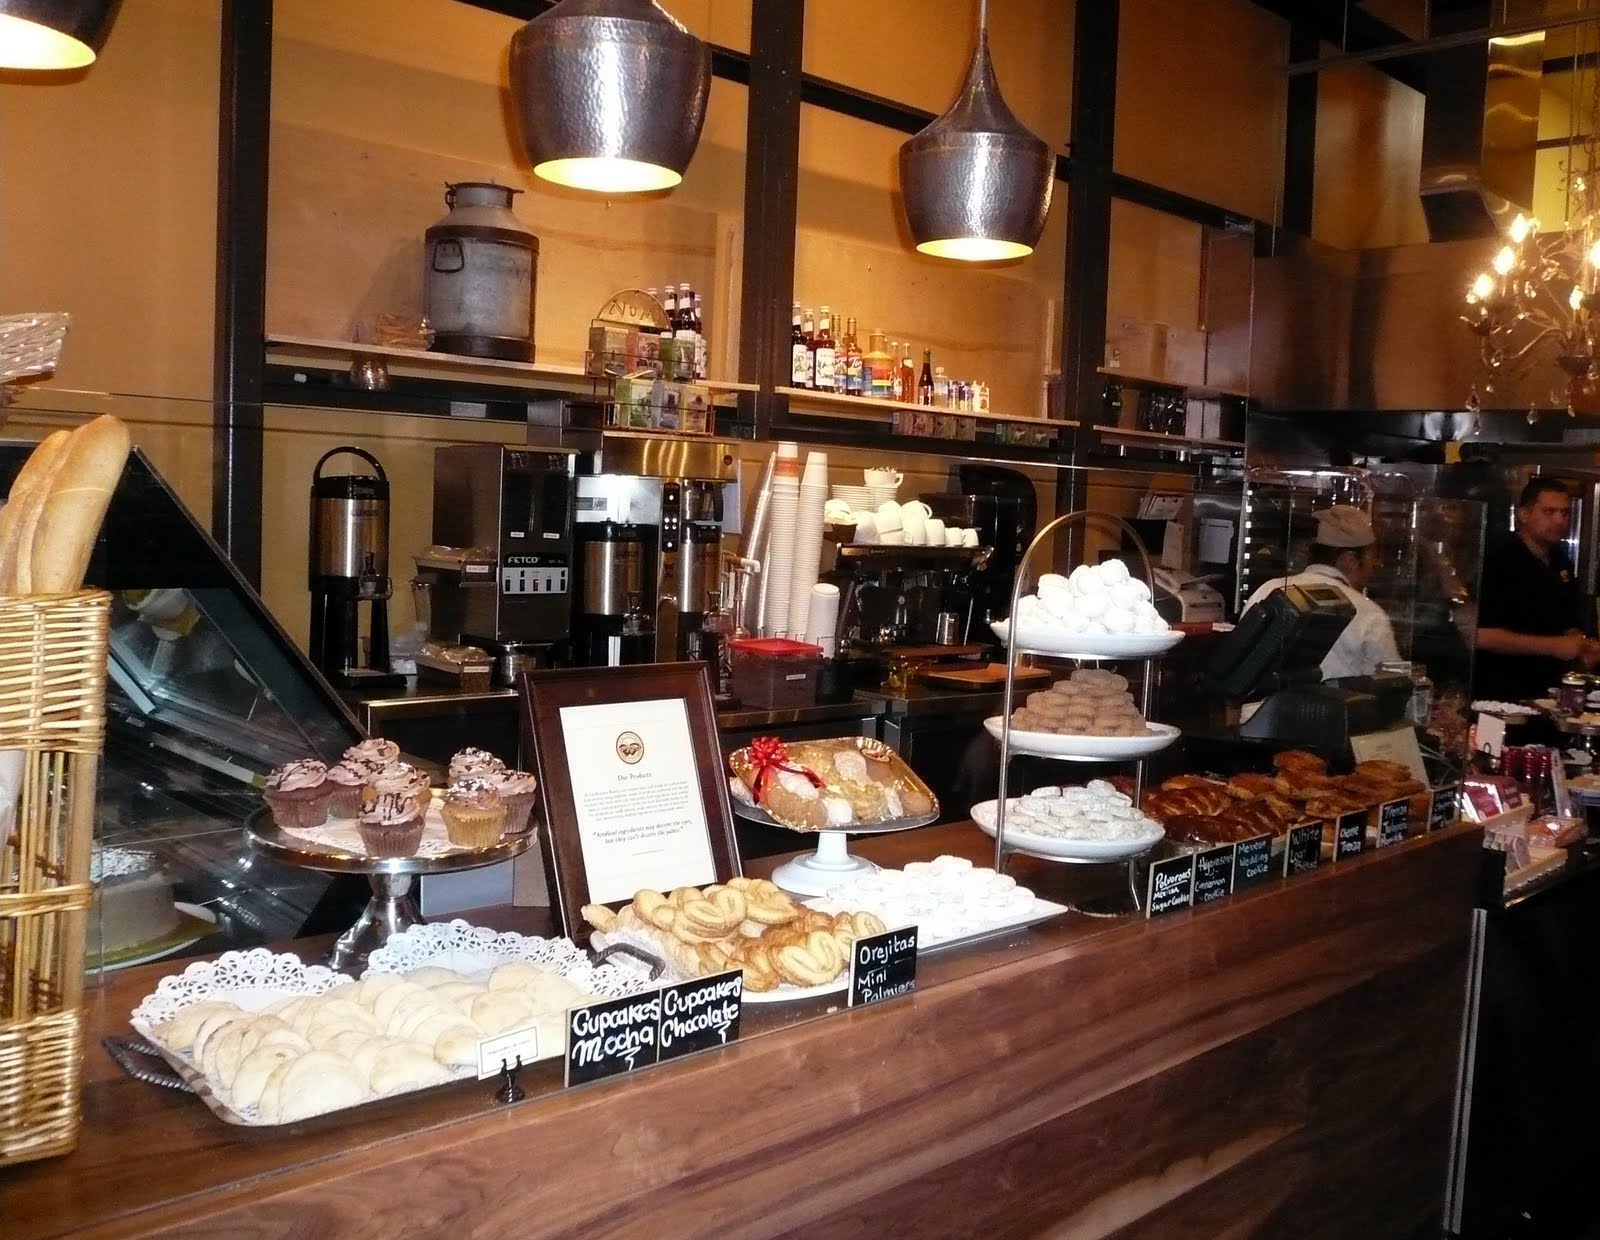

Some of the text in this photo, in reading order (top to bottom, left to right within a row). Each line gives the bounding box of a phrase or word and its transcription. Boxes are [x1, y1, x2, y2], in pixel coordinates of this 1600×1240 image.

[508, 556, 538, 564] FETCO
[629, 772, 652, 780] Products
[645, 824, 655, 832] may
[627, 833, 639, 841] can't
[1292, 828, 1320, 845] White
[1238, 840, 1267, 855] Mexican
[1239, 853, 1269, 867] Wedding
[1246, 864, 1269, 878] Cookie
[1195, 877, 1226, 892] Cinnamon
[1151, 899, 1170, 912] Sugar
[860, 934, 915, 965] Orejitas
[857, 969, 887, 990] Mini
[664, 976, 742, 1016] Cupcakes
[862, 979, 916, 1003] Palmiers
[572, 999, 660, 1038] Cupcakes
[661, 1000, 739, 1048] Chocolate
[571, 1026, 654, 1067] Mocha
